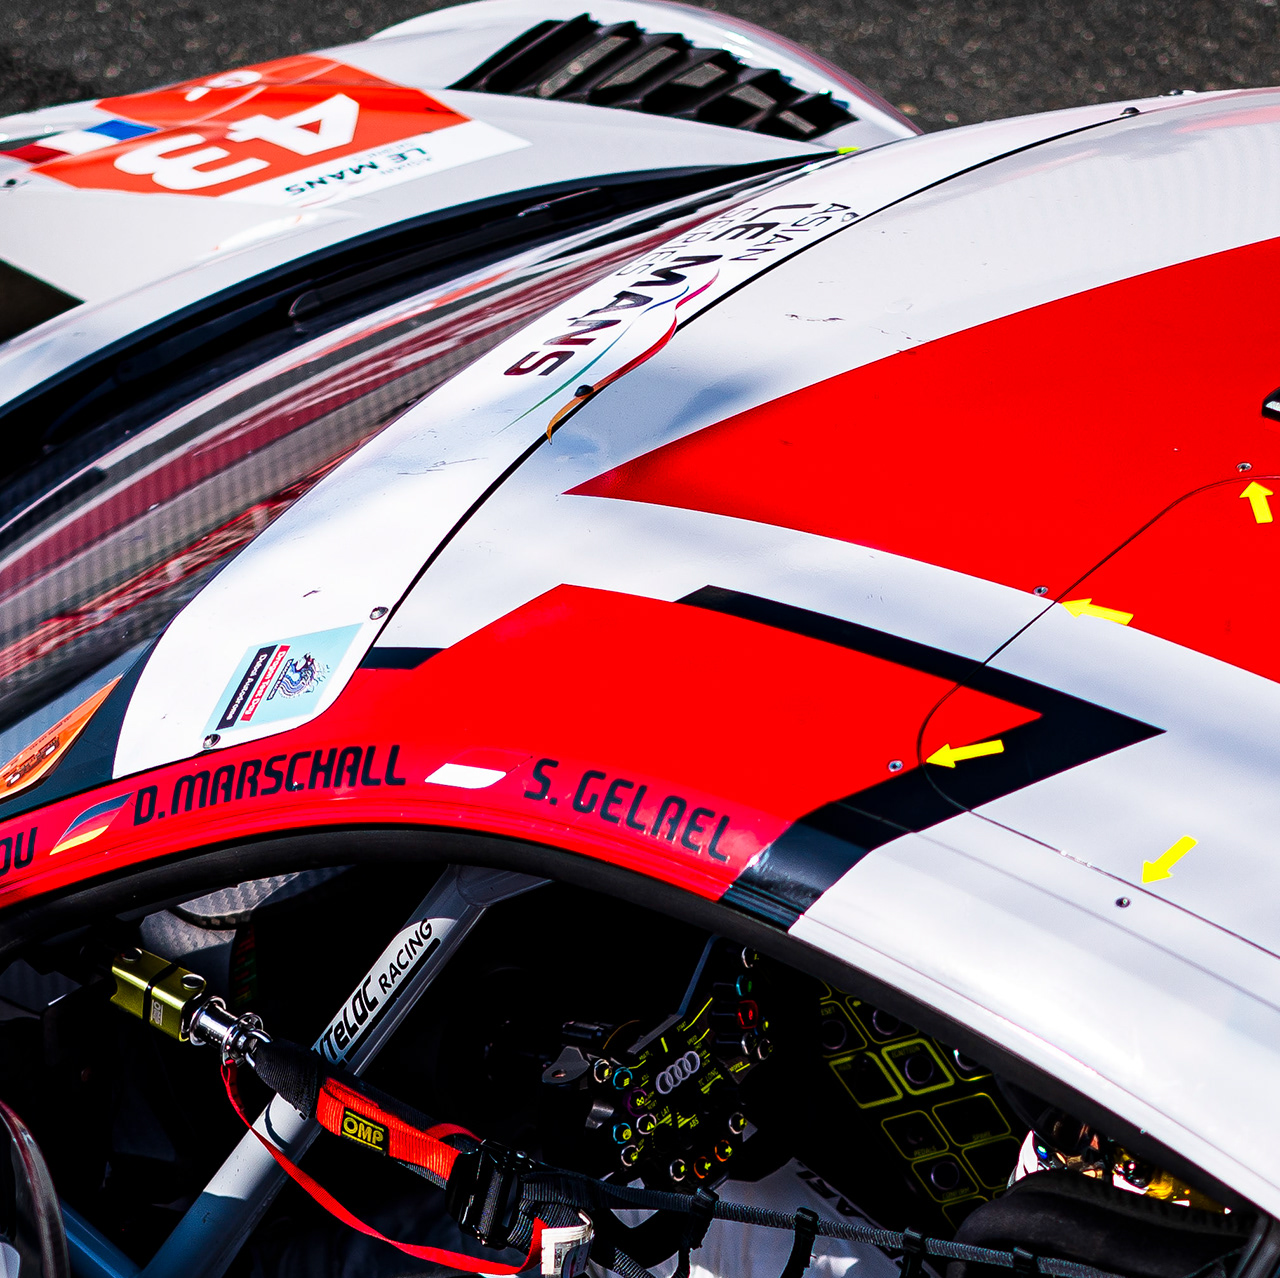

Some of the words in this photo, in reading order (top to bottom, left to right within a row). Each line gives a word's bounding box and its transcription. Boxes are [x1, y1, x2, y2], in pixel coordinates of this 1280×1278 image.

[114, 93, 360, 191] 43
[391, 147, 427, 164] LE
[285, 161, 379, 196] MANS
[616, 206, 758, 277] SERIES
[708, 202, 820, 241] LE
[729, 203, 852, 261] ASIAN
[503, 254, 723, 377] MANS
[523, 757, 559, 806] S.
[572, 769, 731, 863] GELAEL
[378, 918, 433, 995] RACING
[342, 1117, 385, 1147] OMP
